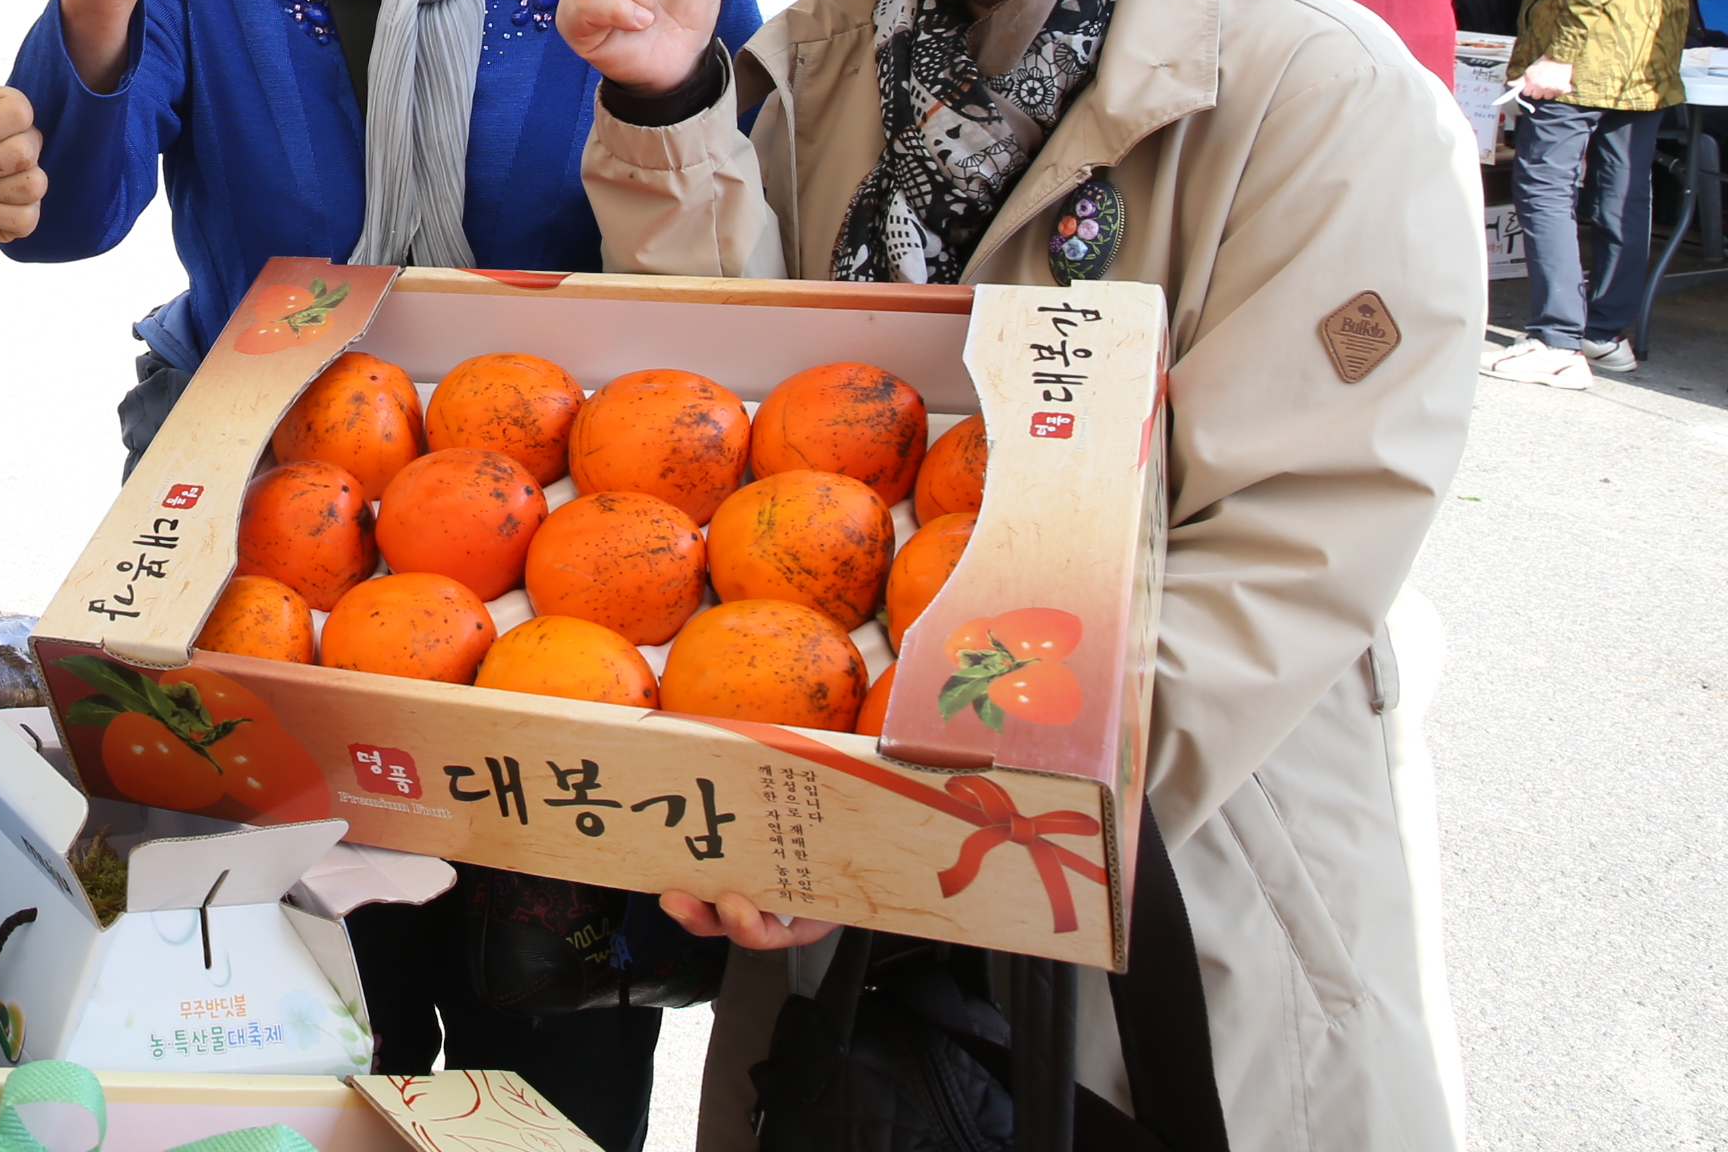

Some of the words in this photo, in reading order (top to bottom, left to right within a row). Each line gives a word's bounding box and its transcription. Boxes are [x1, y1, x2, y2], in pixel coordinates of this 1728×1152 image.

[1030, 302, 1103, 402] 대봉감
[1034, 415, 1071, 436] 명품
[166, 486, 199, 506] 명품
[88, 518, 180, 622] 대봉감
[356, 750, 415, 794] 명품
[758, 764, 778, 803] 깨끗한
[338, 791, 410, 813] Premium
[412, 801, 453, 819] Fruit
[443, 755, 736, 861] 대봉감
[780, 767, 802, 819] 정성으로
[765, 809, 785, 859] 자연에서
[790, 824, 808, 862] 재배한
[775, 864, 792, 902] 농부의
[796, 867, 816, 904] 맛있는
[180, 994, 247, 1020] 무주반딧불
